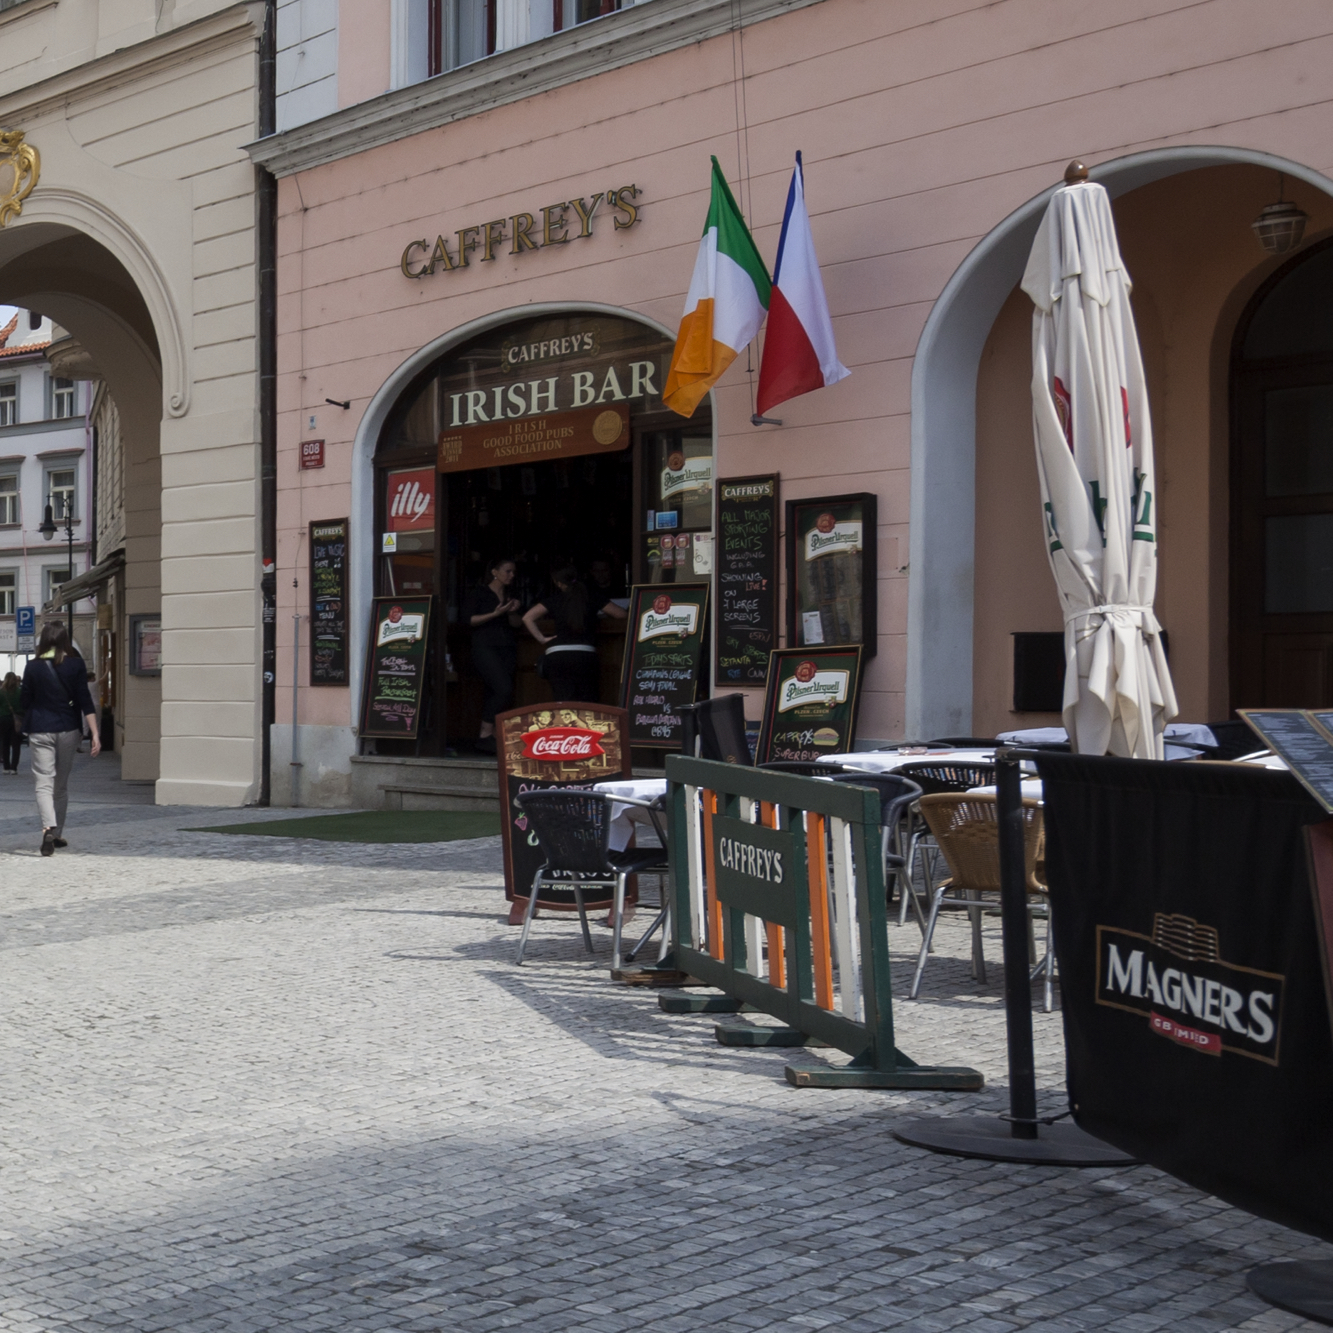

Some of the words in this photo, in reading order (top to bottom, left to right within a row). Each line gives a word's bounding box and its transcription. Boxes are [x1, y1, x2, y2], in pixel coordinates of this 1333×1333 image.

[400, 183, 641, 279] CAFFREY'S
[507, 331, 594, 364] CAFFREY'S
[449, 376, 559, 427] IRISH
[570, 360, 660, 408] BAR
[509, 419, 547, 435] IRISH
[483, 435, 513, 449] GOOD
[514, 430, 544, 444] FOOD
[546, 426, 575, 440] PUBS
[303, 442, 320, 455] 608
[493, 439, 562, 458] ASSOCIATION
[391, 481, 431, 523] illy
[721, 511, 740, 523] ALL
[724, 522, 768, 537] SPORTING
[725, 536, 762, 550] EVENTS
[721, 572, 763, 583] SHOWING
[733, 598, 759, 612] LARGE
[20, 610, 31, 627] P
[724, 612, 761, 623] SCREENS
[786, 682, 813, 702] Pilsner
[813, 681, 841, 696] Urquell
[532, 735, 593, 756] Coca-Cola
[719, 837, 783, 884] CAFFREY'S
[1106, 943, 1275, 1044] MAGNERS
